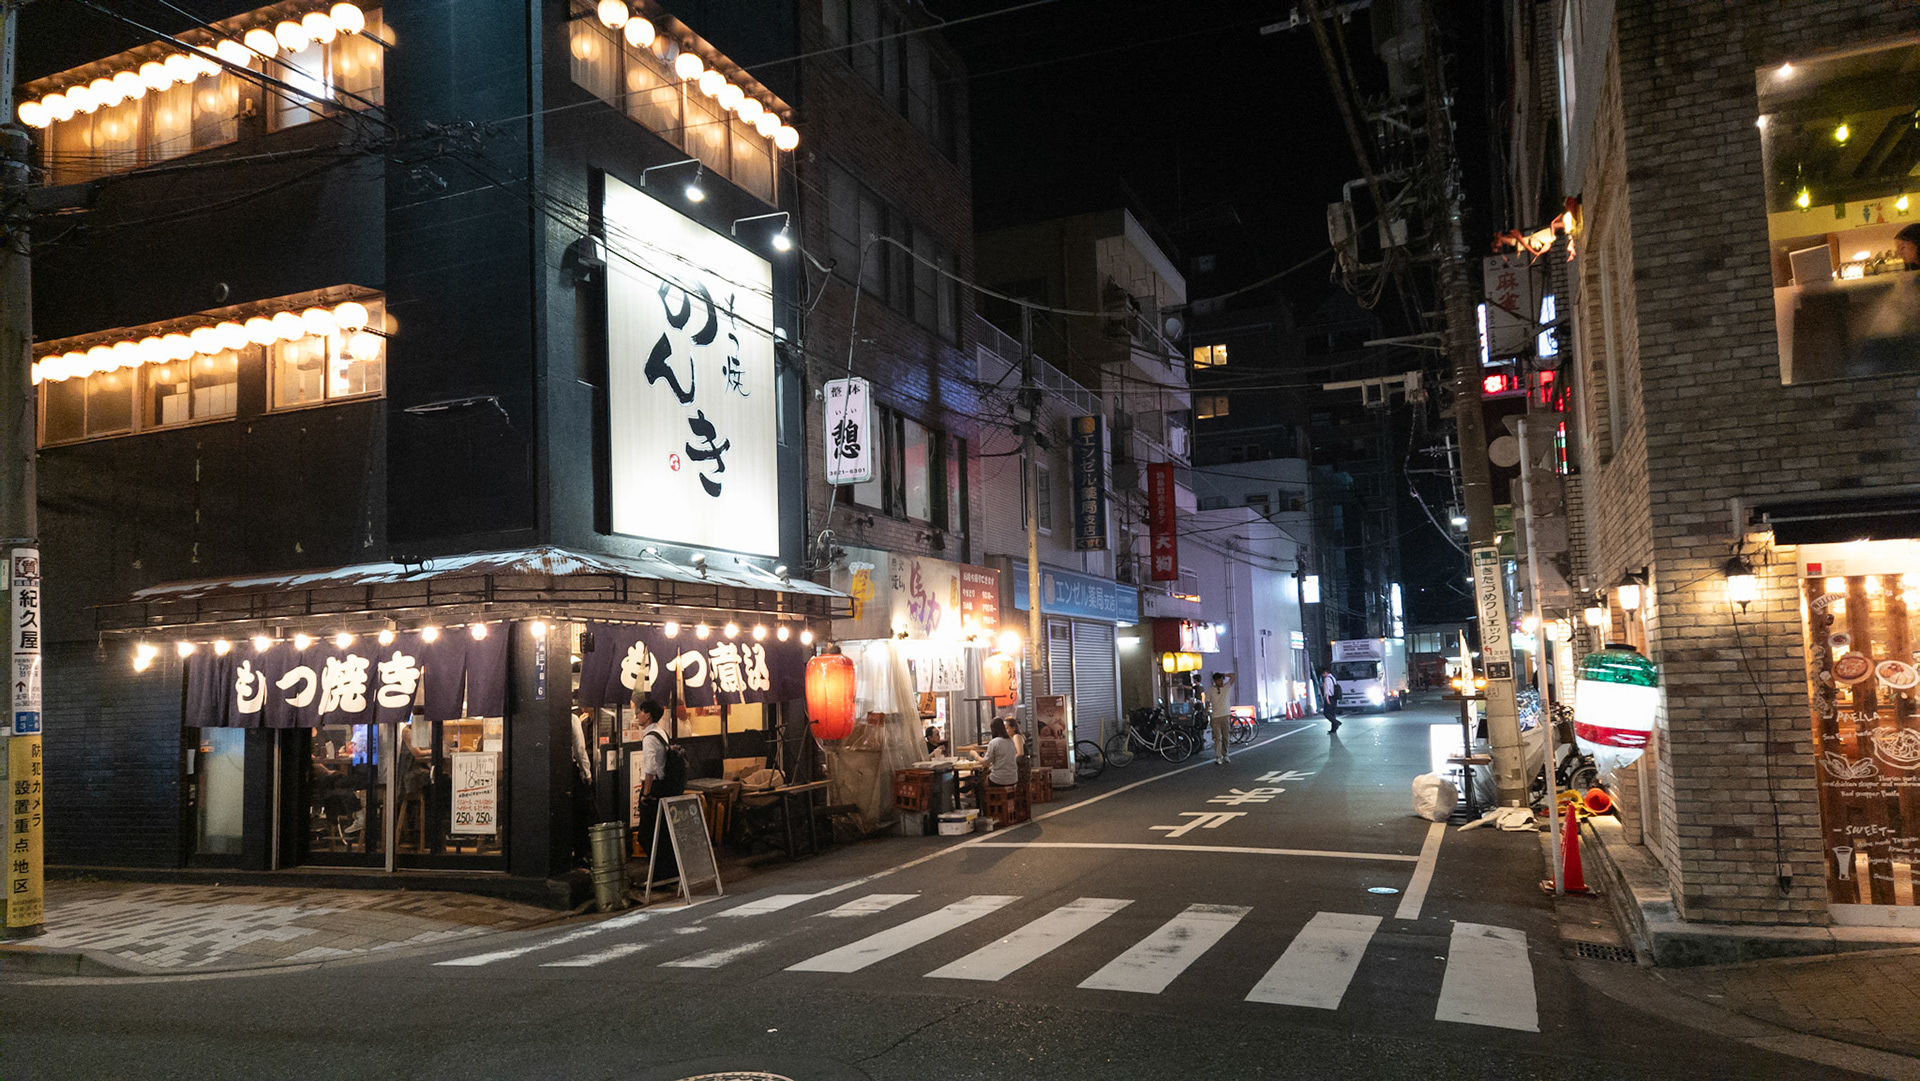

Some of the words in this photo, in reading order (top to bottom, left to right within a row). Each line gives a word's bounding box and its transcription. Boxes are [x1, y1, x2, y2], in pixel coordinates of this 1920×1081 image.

[644, 275, 731, 498] のんき
[830, 384, 861, 398] 整体
[831, 419, 861, 460] 憩
[1080, 434, 1097, 535] エンゼル薬局支店
[19, 589, 38, 649] 紀久屋
[1055, 580, 1116, 612] エンゼル薬局支店
[235, 650, 420, 716] もつ焼き
[620, 640, 771, 692] もつ煮込
[1836, 711, 1882, 723] PAELLA
[31, 743, 41, 827] 防犯カメラ
[1148, 770, 1316, 838] 止まれ
[13, 779, 31, 894] 設置重点地区
[1845, 824, 1888, 837] SWEET
